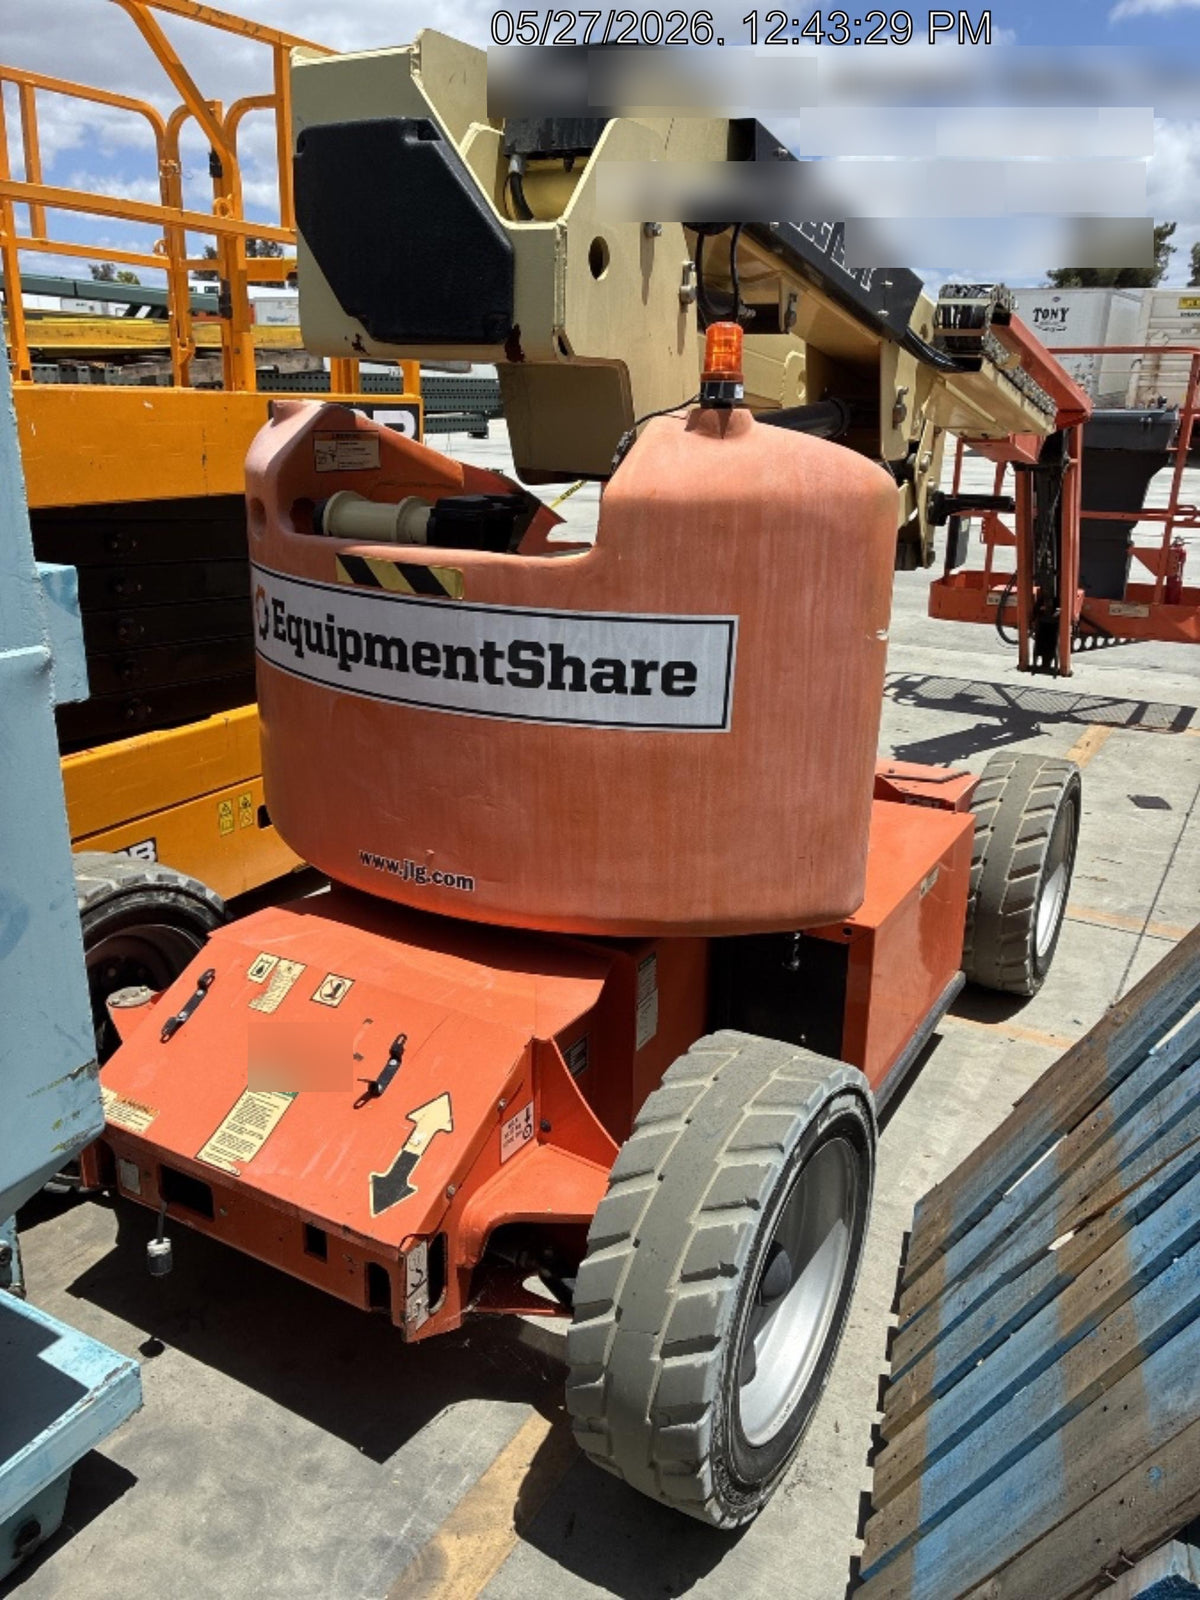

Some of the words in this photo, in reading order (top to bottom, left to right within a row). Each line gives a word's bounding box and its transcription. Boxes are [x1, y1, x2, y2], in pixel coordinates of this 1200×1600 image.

[1032, 307, 1070, 322] TONY
[271, 596, 699, 699] EquipmentShare
[359, 850, 475, 892] www.jlg.com
